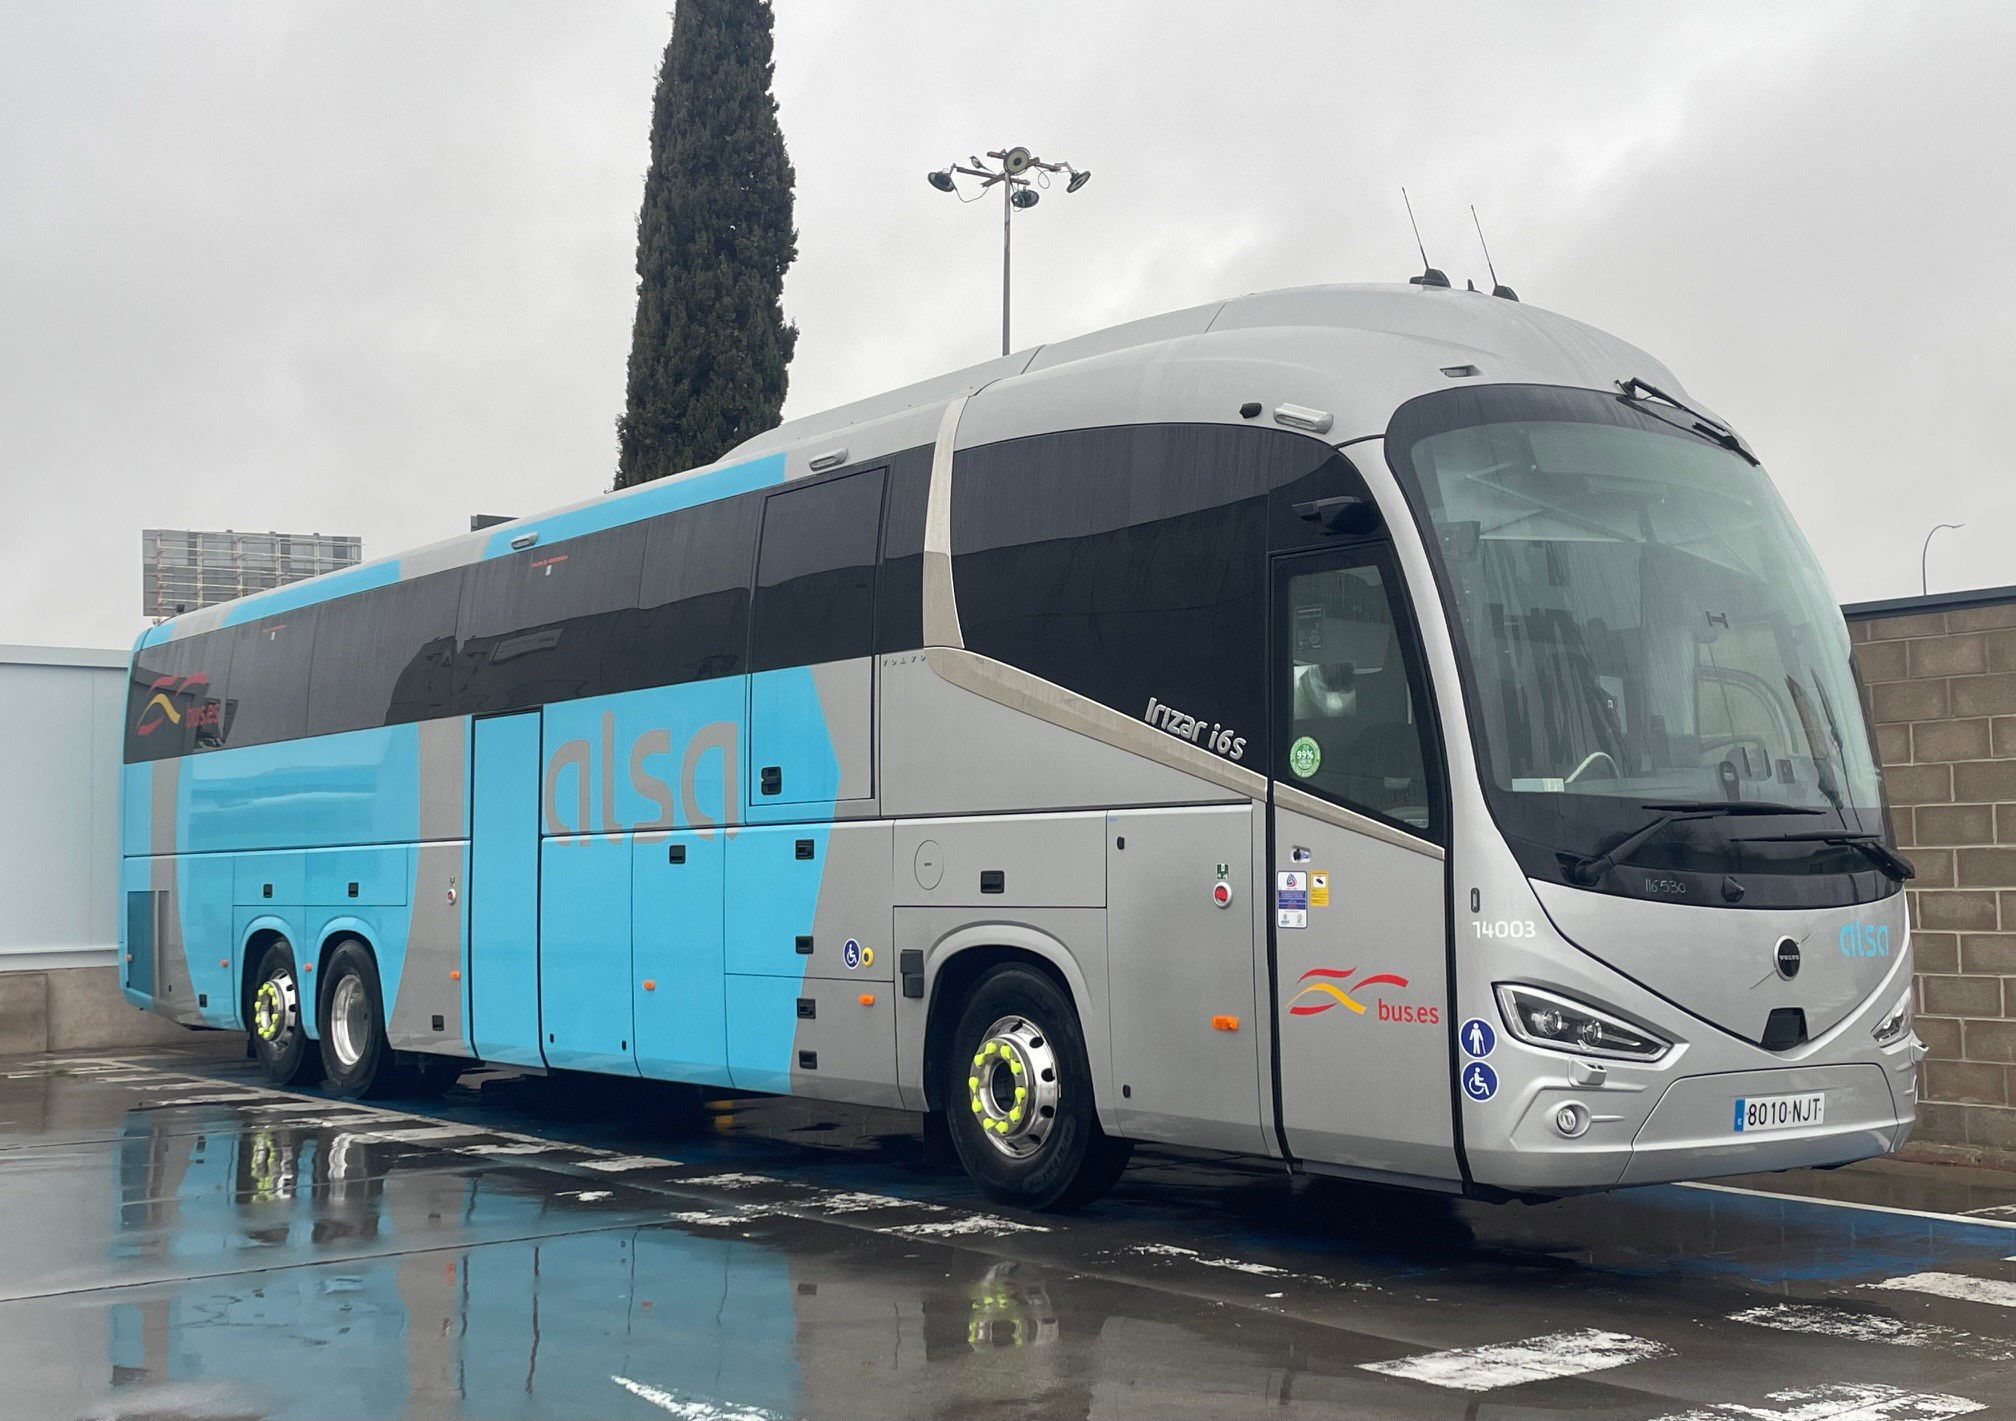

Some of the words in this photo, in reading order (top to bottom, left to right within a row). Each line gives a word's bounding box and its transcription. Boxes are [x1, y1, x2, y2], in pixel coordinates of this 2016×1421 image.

[1144, 697, 1208, 743] Irizar
[1208, 723, 1247, 760] i6s
[1296, 750, 1314, 759] 99%
[545, 709, 738, 847] alsa
[1645, 878, 1686, 893] 116530
[1472, 920, 1536, 938] 14003
[1839, 917, 1889, 957] alsa
[1378, 998, 1439, 1024] bus.es
[1748, 1102, 1788, 1126] 8010
[1792, 1098, 1820, 1122] NJT
